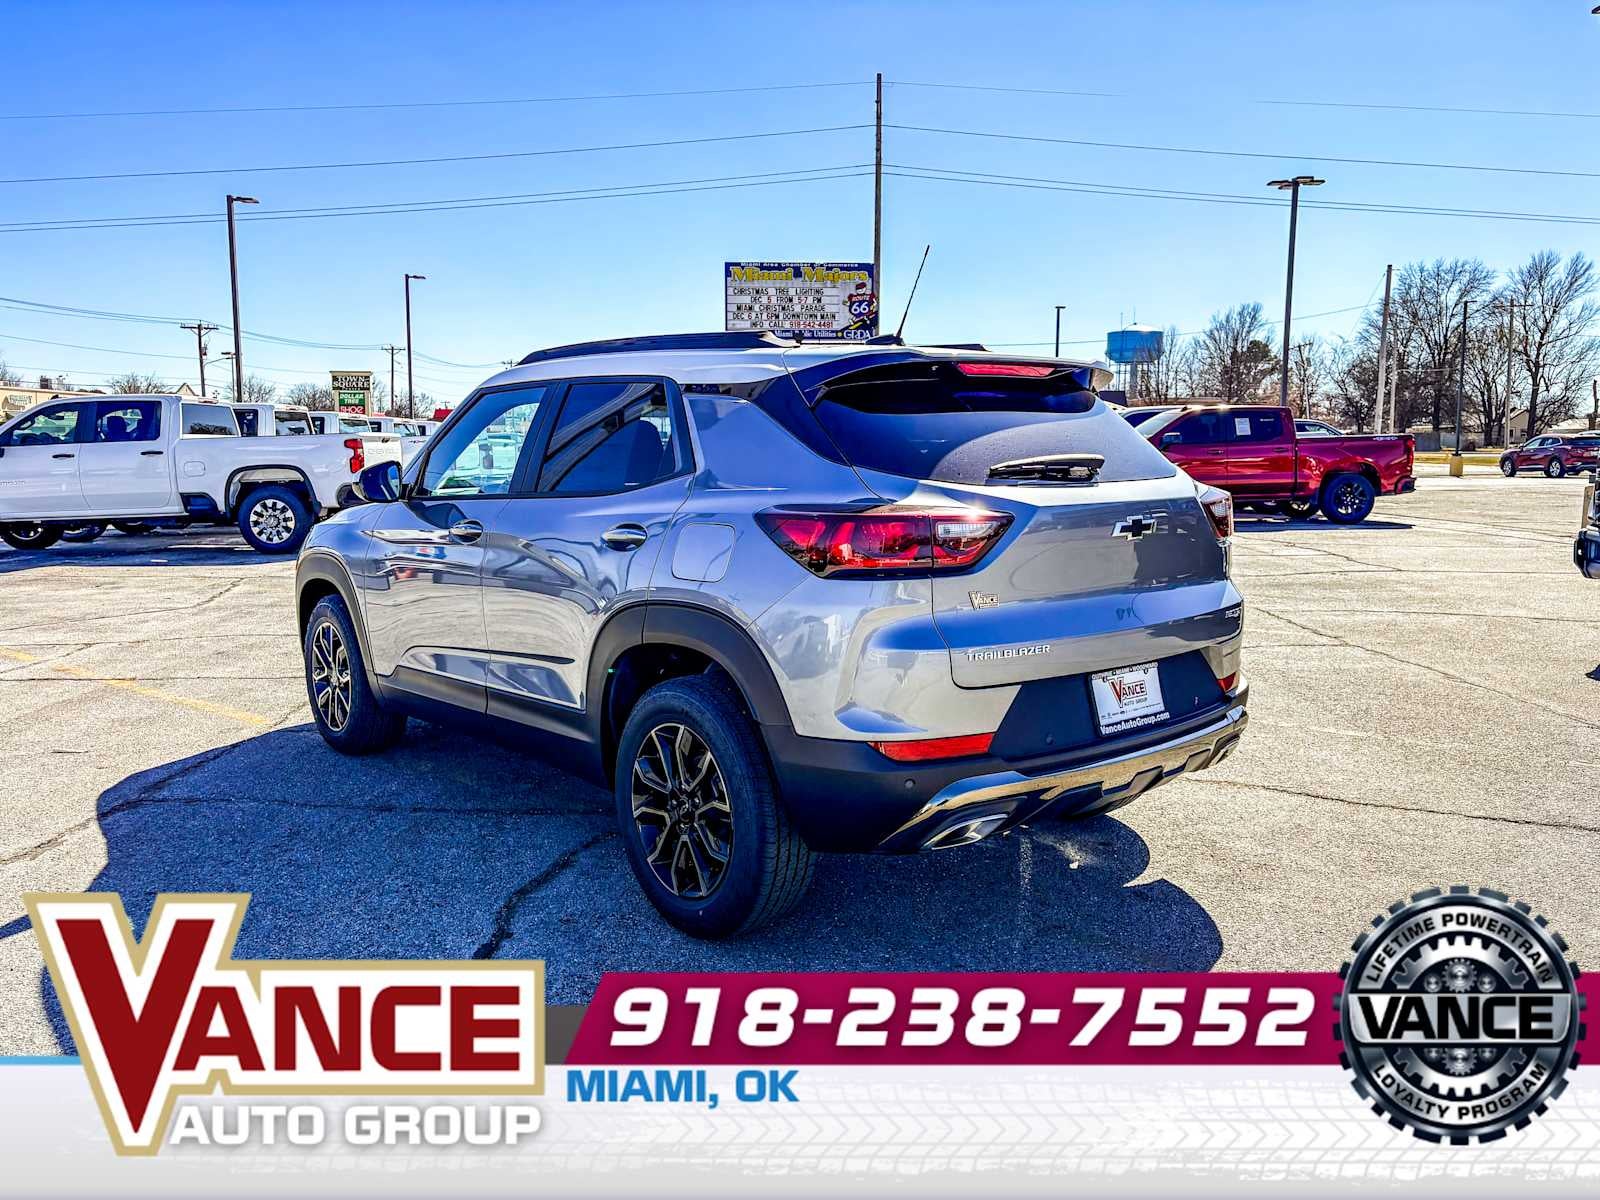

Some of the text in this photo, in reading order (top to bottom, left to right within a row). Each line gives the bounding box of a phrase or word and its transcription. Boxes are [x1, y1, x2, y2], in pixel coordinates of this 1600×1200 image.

[730, 266, 868, 284] Miami Majors
[795, 288, 824, 296] LIGHTING
[750, 296, 762, 304] DEC
[767, 296, 772, 304] 5
[776, 296, 793, 304] FROM
[736, 304, 755, 312] MIAMI
[759, 304, 795, 312] CHRISTMAS
[851, 302, 869, 314] 66
[733, 312, 745, 320] DEC
[747, 312, 753, 320] 6
[754, 312, 763, 320] AT
[766, 312, 780, 320] 6PM
[782, 312, 818, 320] DOWNTOWN
[768, 320, 784, 328] CALL
[333, 381, 370, 389] SQUARE
[966, 644, 1051, 662] TRAILBLAZER
[1108, 677, 1147, 708] VANCE
[1100, 712, 1170, 735] VanceAutoGroup.com
